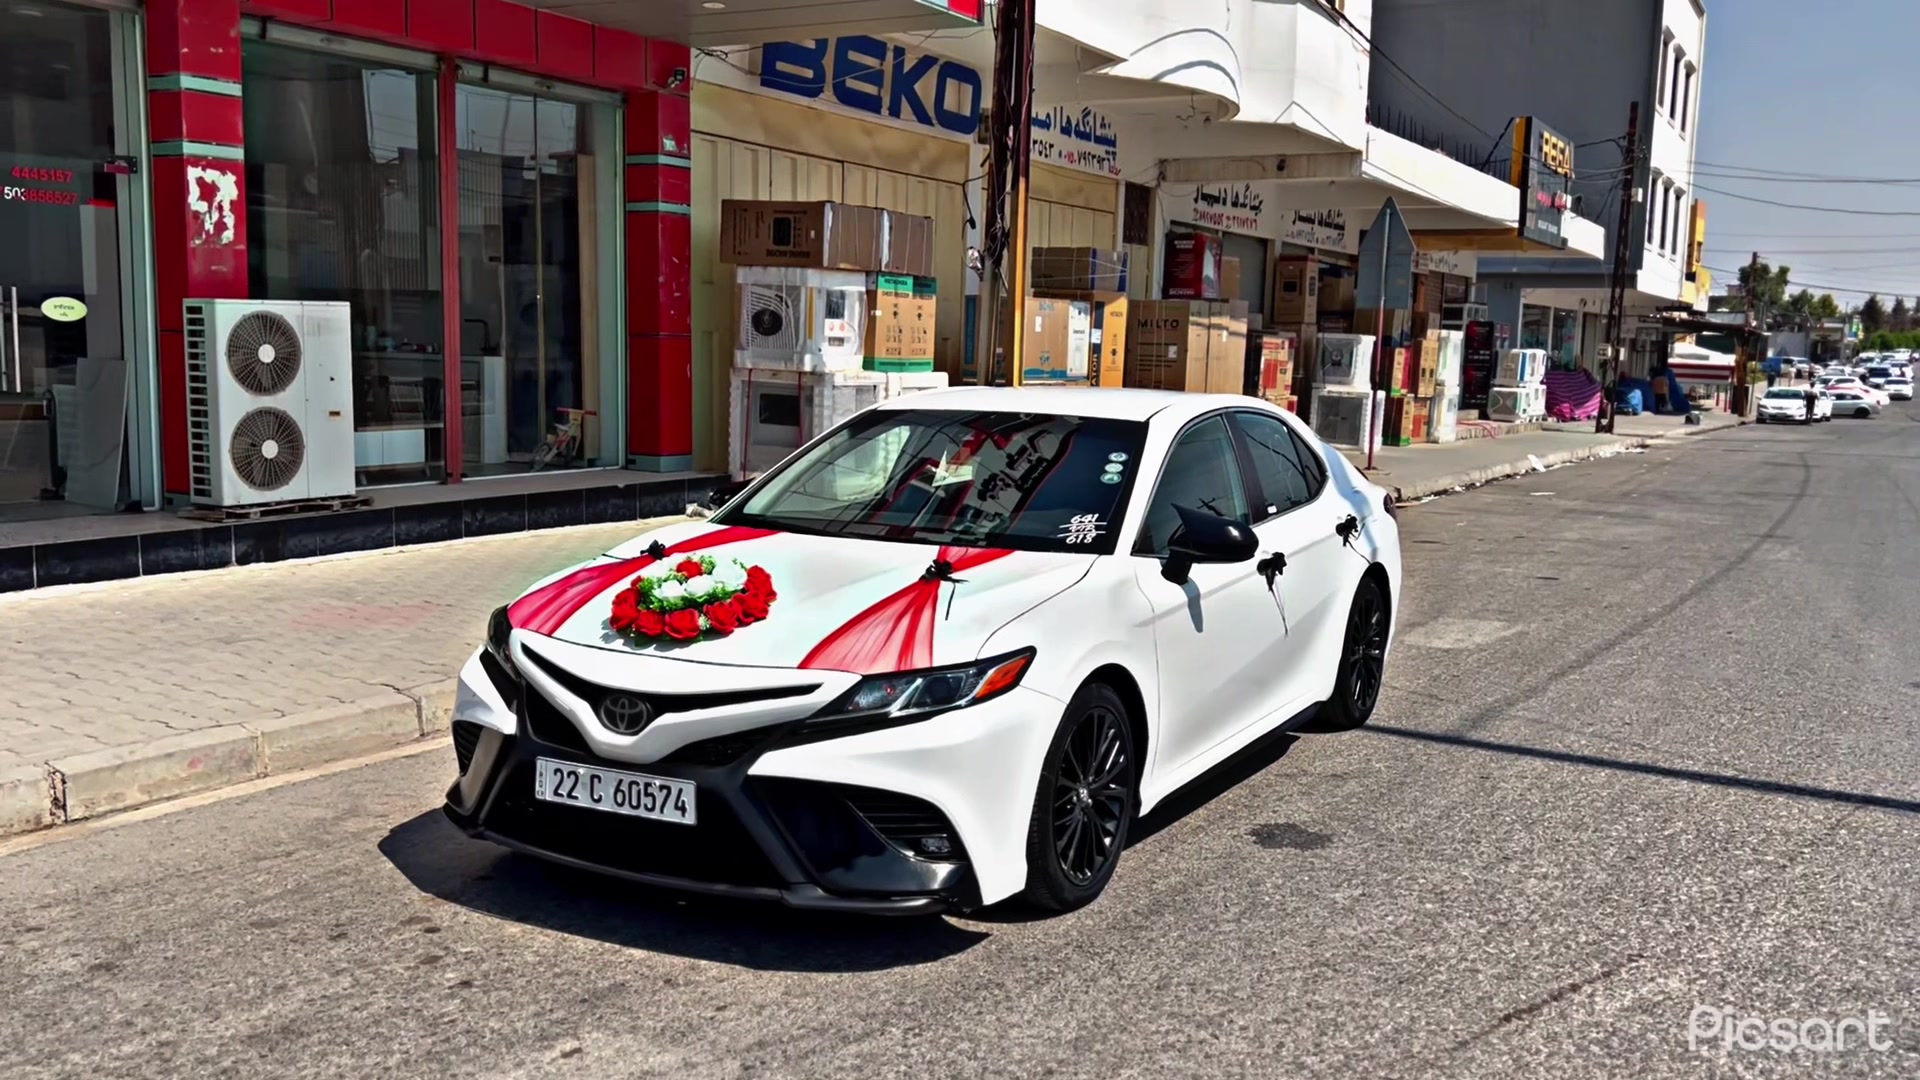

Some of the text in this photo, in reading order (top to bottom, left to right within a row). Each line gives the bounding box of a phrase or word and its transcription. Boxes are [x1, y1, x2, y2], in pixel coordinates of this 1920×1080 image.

[760, 35, 982, 135] BEKO
[553, 767, 688, 818] 22 C 60574
